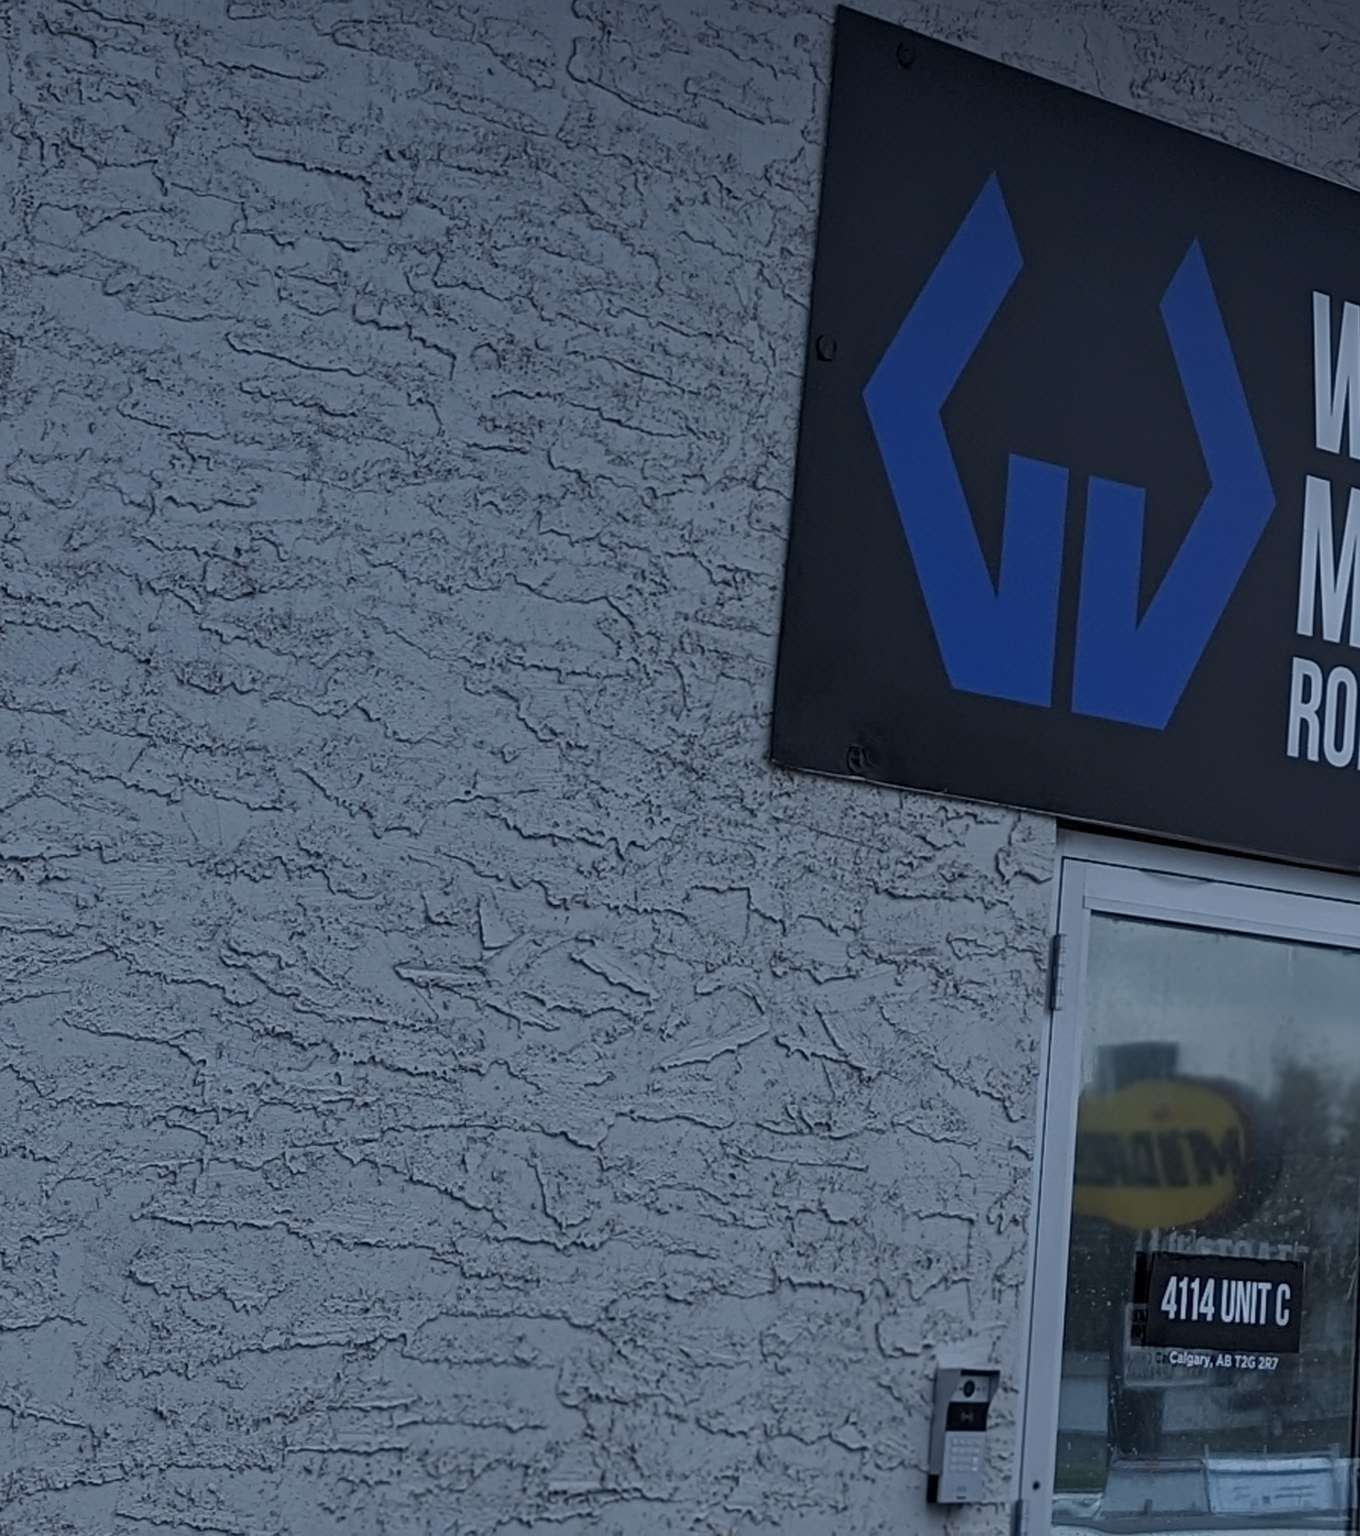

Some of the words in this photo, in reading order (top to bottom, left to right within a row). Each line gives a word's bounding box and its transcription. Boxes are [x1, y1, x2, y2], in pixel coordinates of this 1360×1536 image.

[1160, 1275, 1216, 1322] 4114
[1220, 1278, 1273, 1325] UNIT
[1275, 1282, 1292, 1327] C
[1169, 1350, 1214, 1369] Calgary,
[1215, 1353, 1232, 1367] AB
[1234, 1354, 1256, 1369] T2G
